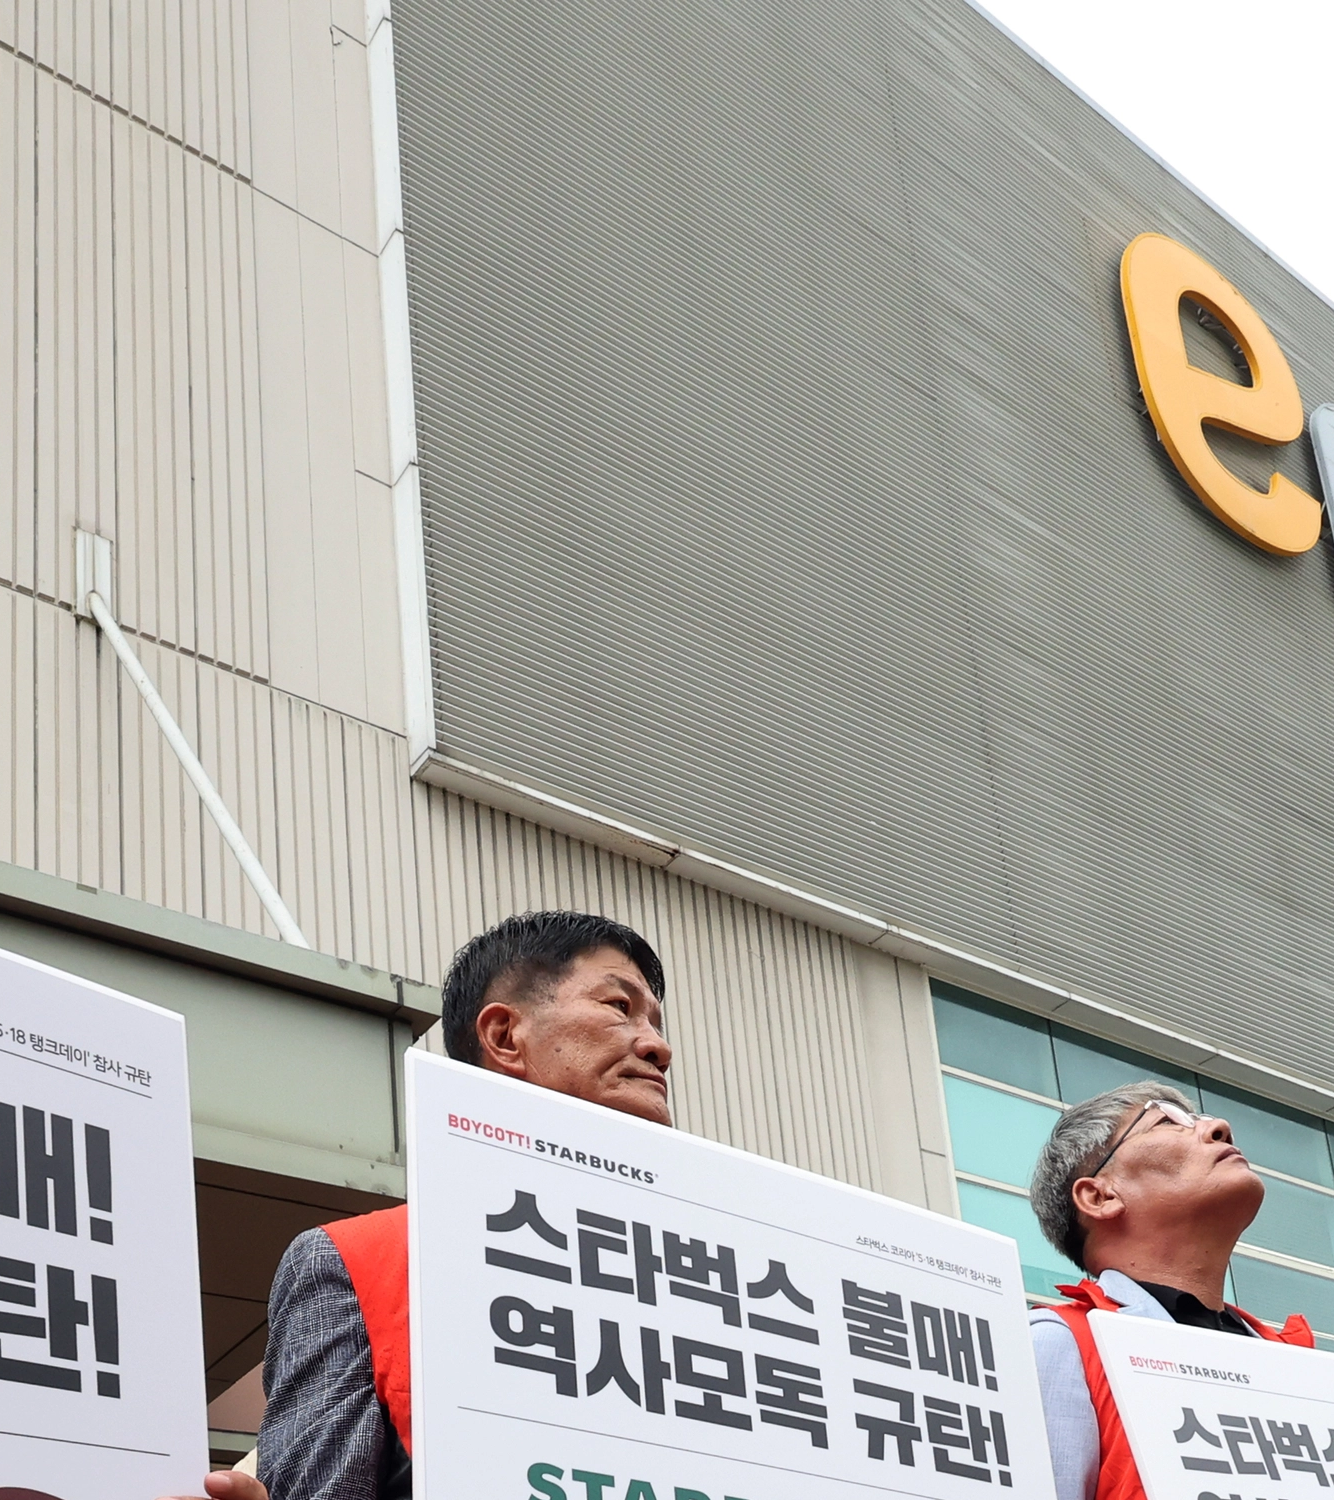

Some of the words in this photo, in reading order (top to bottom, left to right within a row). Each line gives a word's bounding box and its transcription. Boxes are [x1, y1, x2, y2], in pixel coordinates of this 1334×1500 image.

[29, 1032, 90, 1068] 탱크데이'
[92, 1053, 122, 1078] 참사
[123, 1064, 152, 1087] 규탄
[447, 1113, 531, 1150] BOYCOTT!
[534, 1138, 655, 1185] STARBUCKS
[484, 1188, 821, 1346] 스타벅스
[841, 1277, 999, 1392] 불매!
[488, 1294, 830, 1450] 역사모독
[852, 1377, 1013, 1488] 규탄!
[1128, 1355, 1179, 1374] BOYCOTT!
[1178, 1363, 1251, 1385] STARBUCKS
